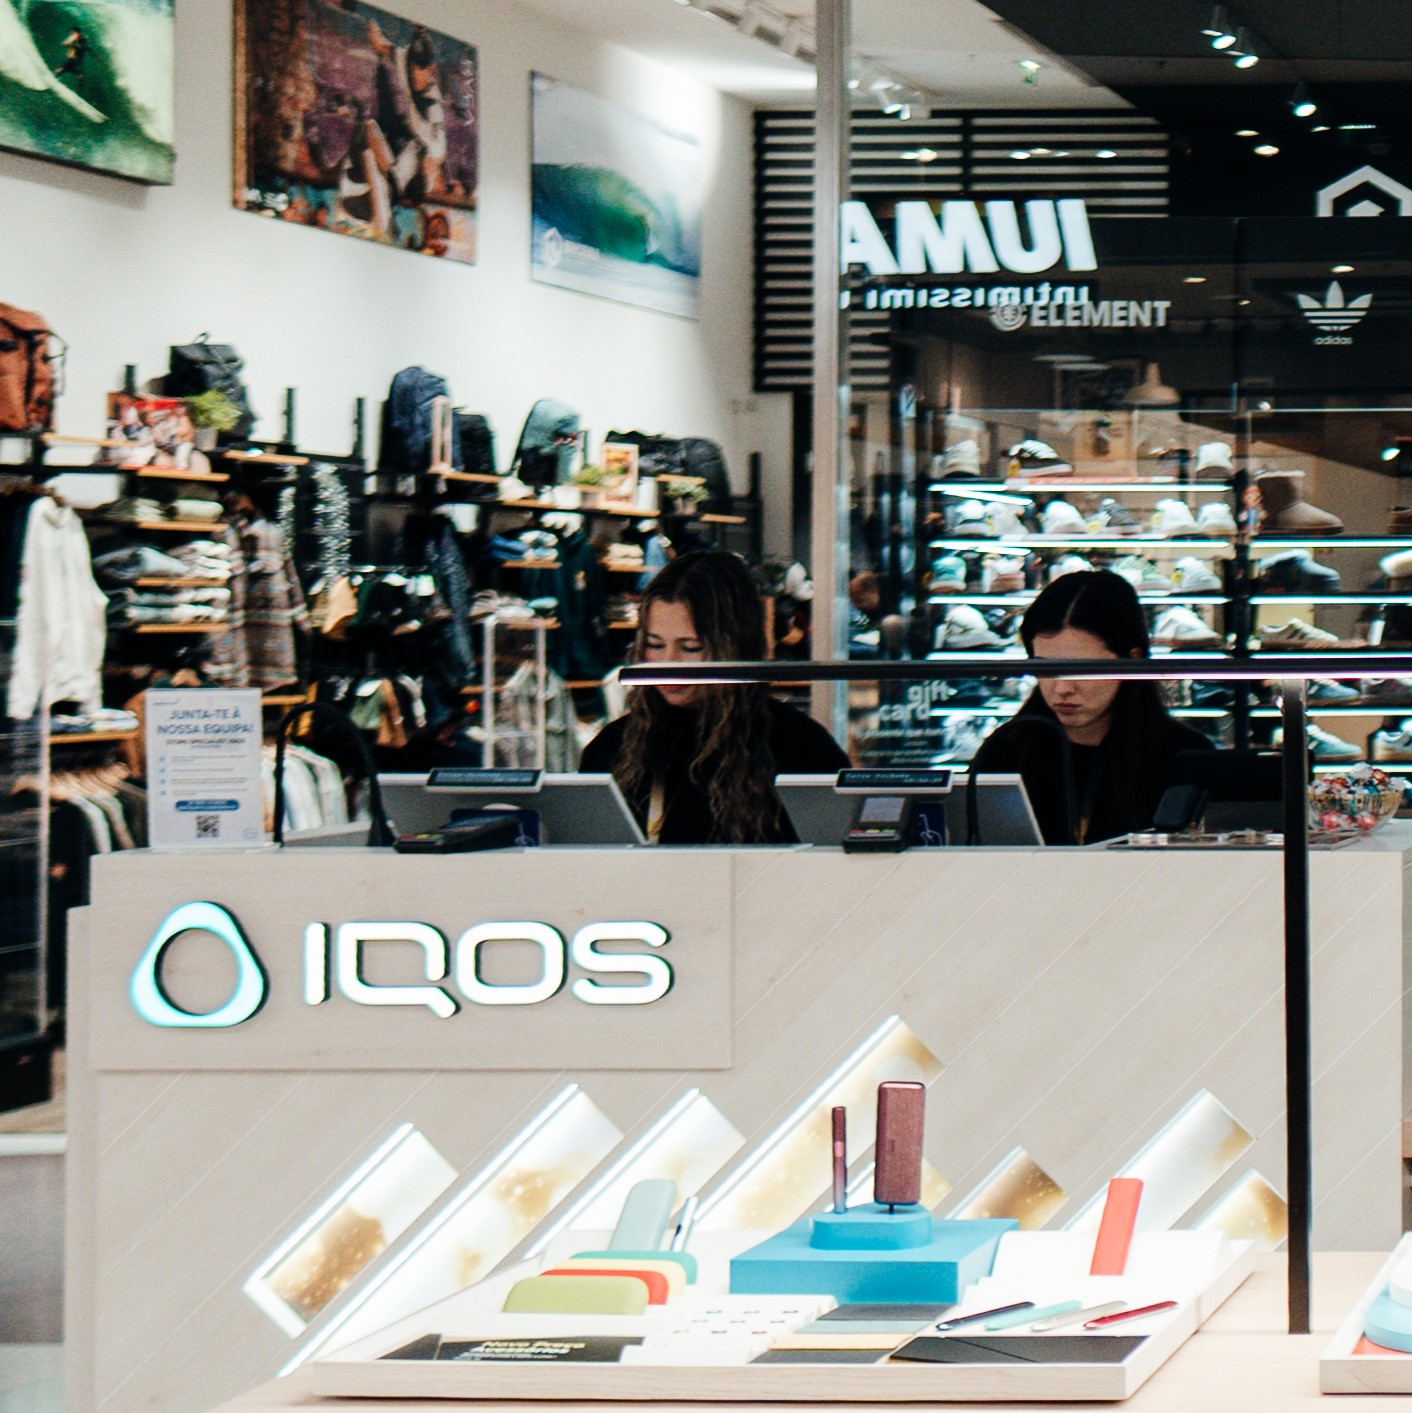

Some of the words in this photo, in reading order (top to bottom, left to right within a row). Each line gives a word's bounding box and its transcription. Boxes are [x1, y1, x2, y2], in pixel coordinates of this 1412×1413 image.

[1030, 300, 1172, 328] ELEMENT
[1314, 335, 1353, 346] adidas
[907, 679, 949, 703] gift
[878, 700, 931, 721] card
[157, 723, 200, 734] NOSSA
[304, 920, 673, 1019] IQOS
